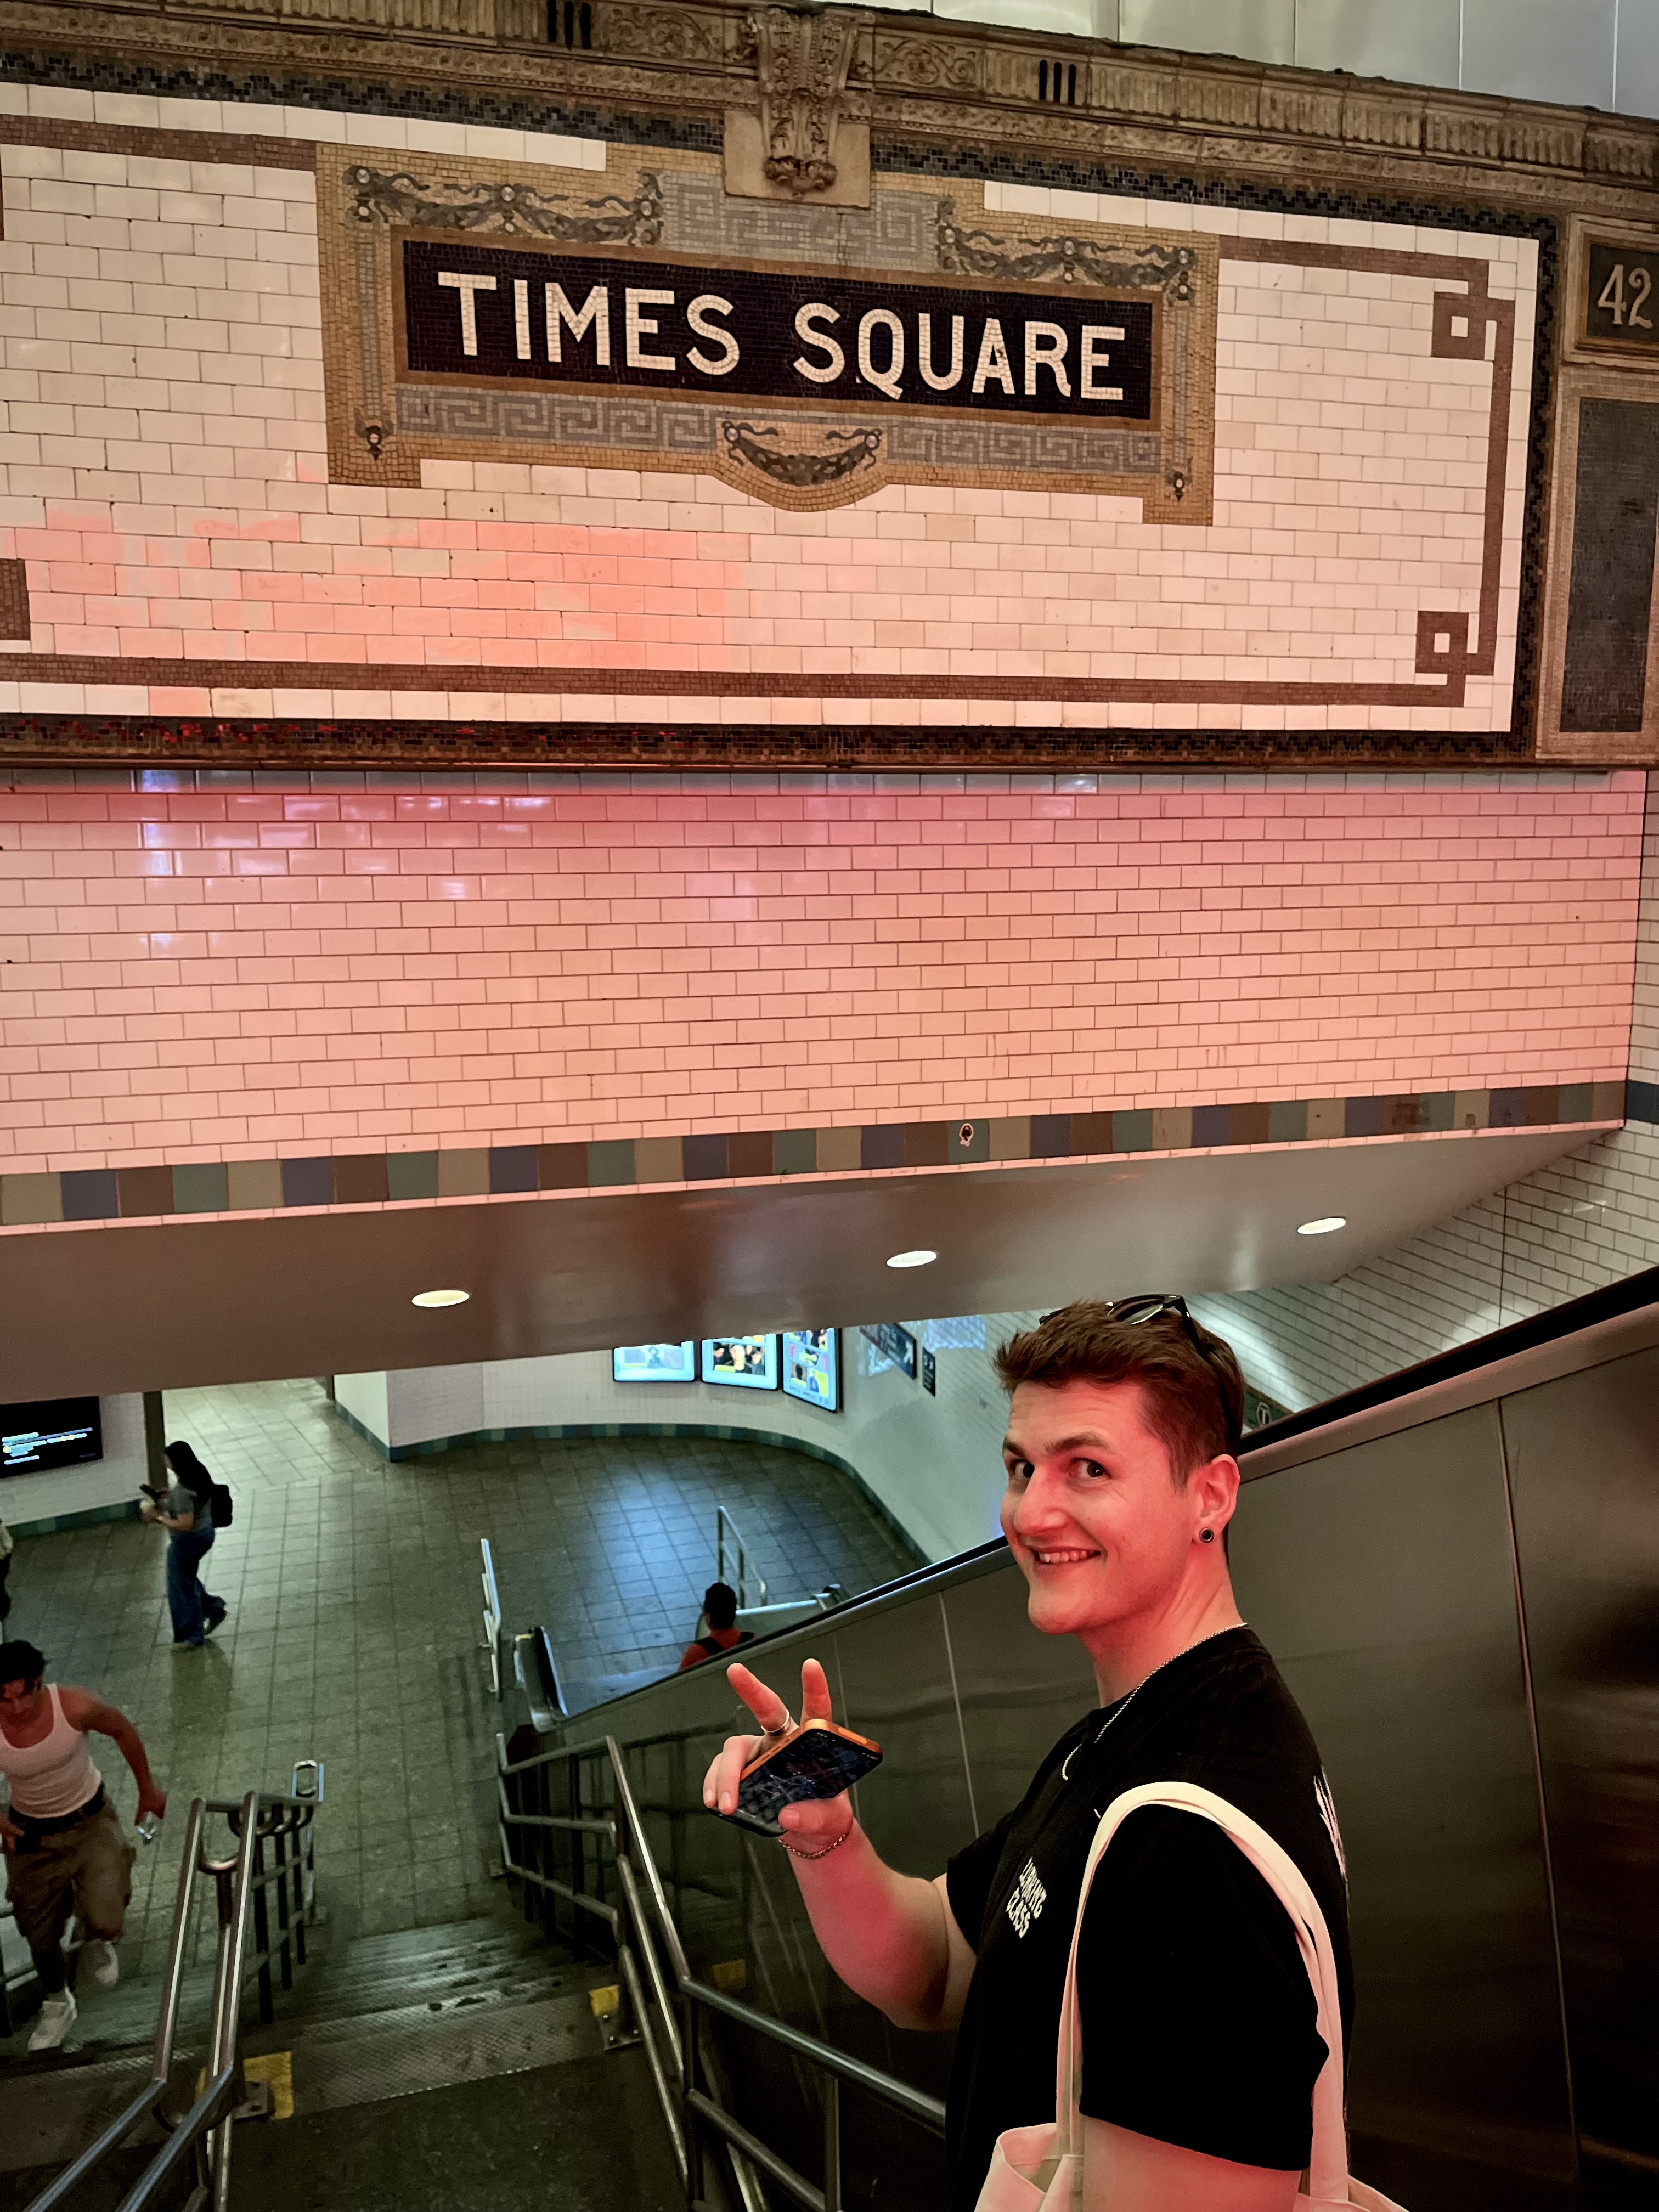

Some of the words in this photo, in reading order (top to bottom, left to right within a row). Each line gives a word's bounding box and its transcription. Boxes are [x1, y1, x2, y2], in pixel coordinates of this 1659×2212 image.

[1597, 264, 1654, 329] 42
[438, 272, 740, 375] TIMES
[793, 303, 1125, 400] SQUARE
[1005, 1886, 1031, 1939] CLASS
